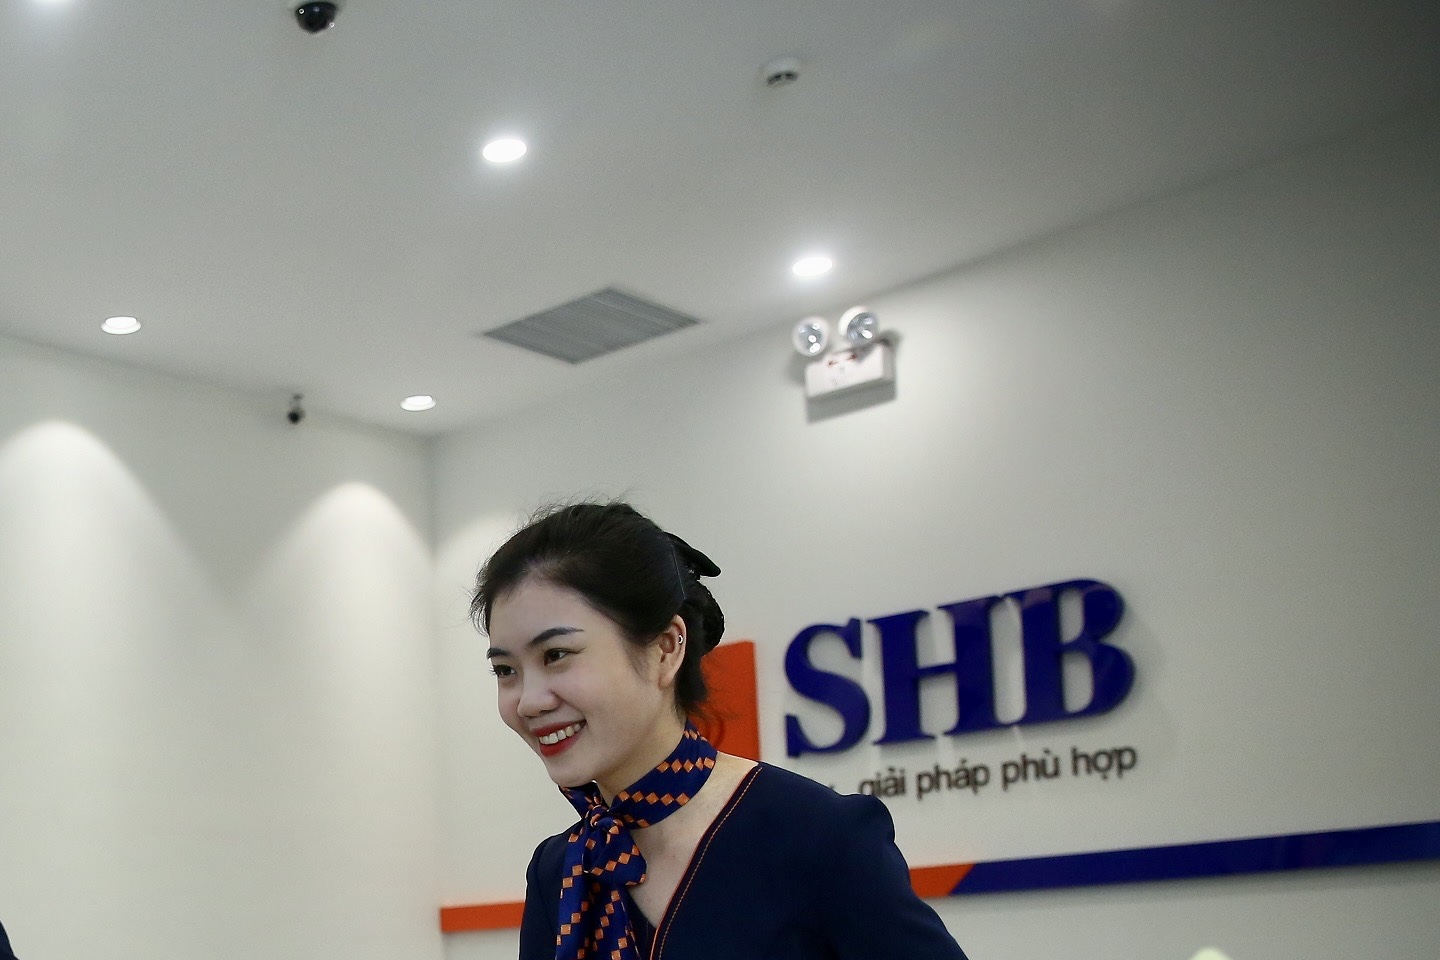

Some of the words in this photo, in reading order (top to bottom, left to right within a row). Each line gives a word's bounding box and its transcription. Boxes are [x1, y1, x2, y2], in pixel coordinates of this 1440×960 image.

[784, 577, 1137, 758] SHB
[915, 758, 991, 801] pháp
[1001, 748, 1061, 791] phù
[1071, 744, 1138, 779] hợp
